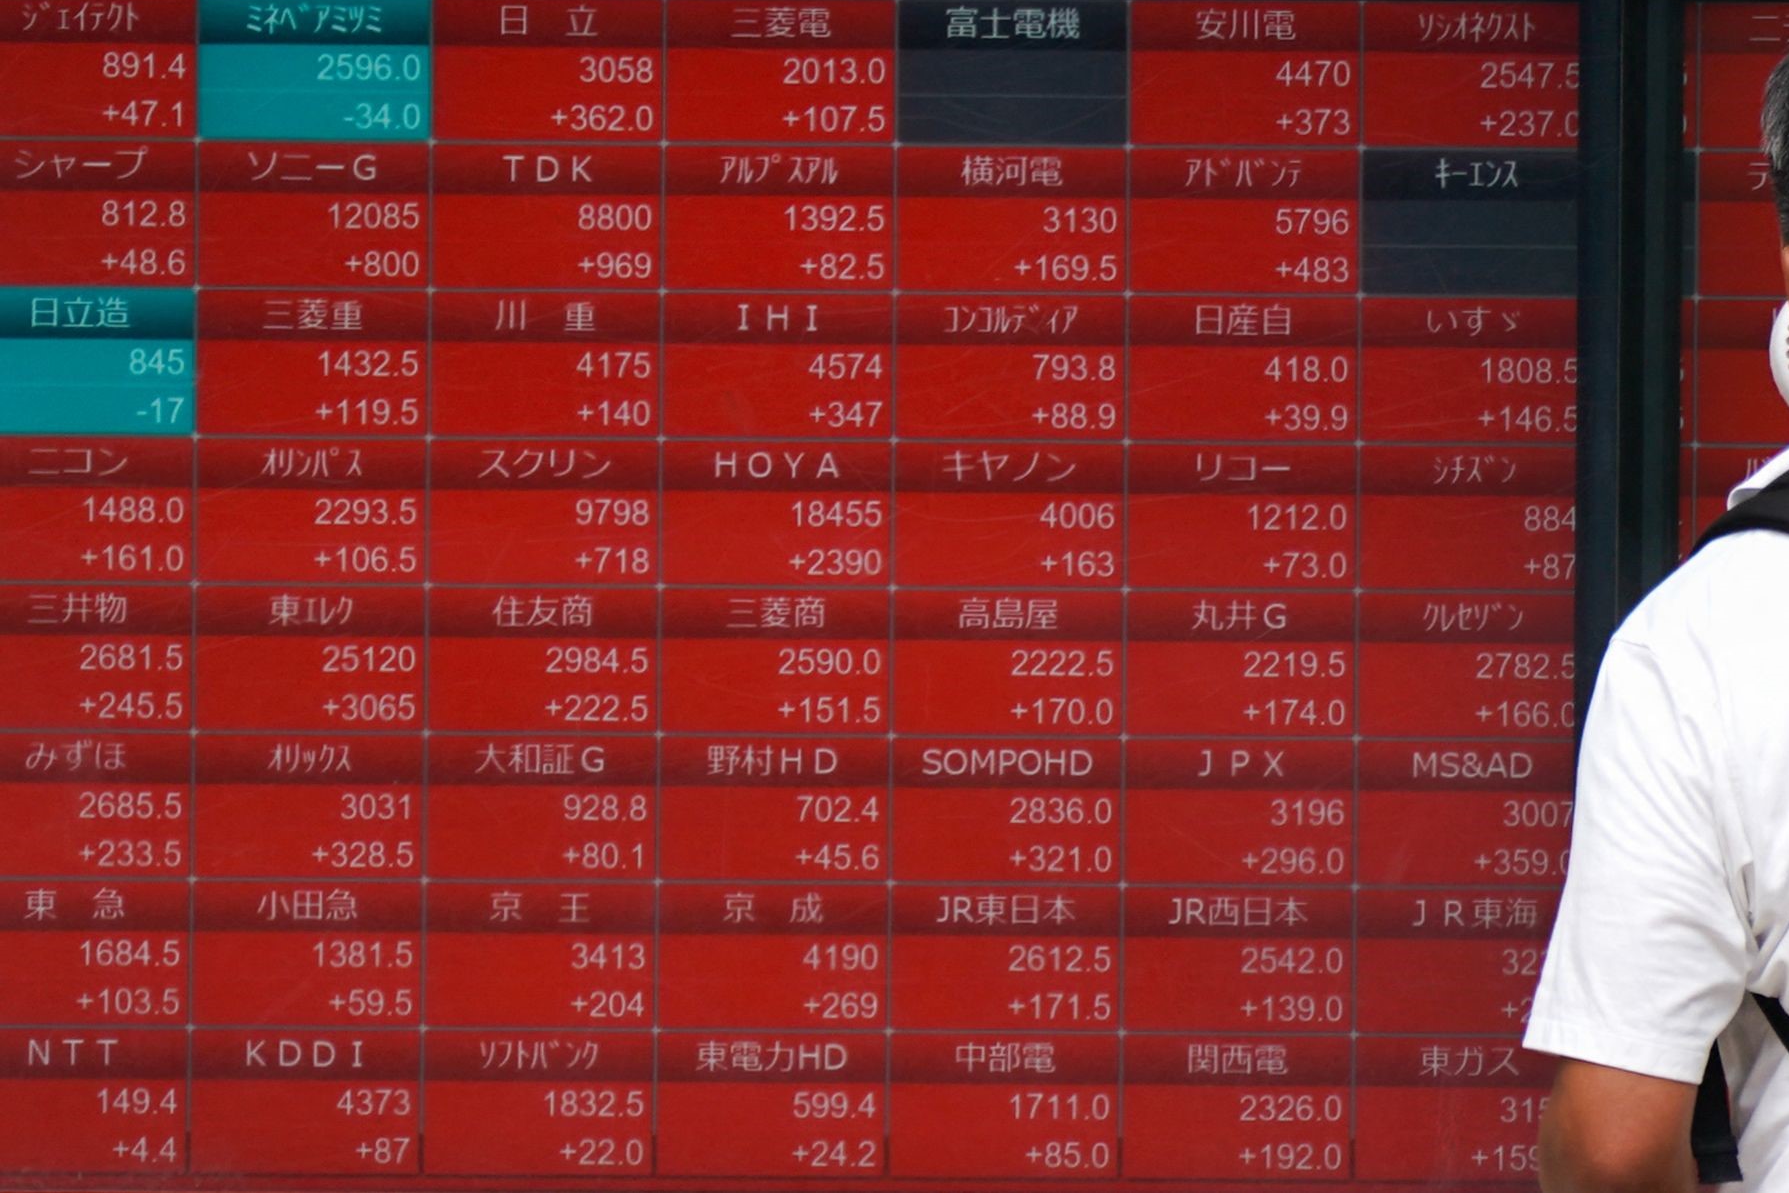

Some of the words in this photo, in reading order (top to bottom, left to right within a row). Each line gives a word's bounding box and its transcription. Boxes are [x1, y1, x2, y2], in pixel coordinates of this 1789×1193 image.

[945, 5, 1080, 39] 富士電機
[1196, 8, 1297, 41] 安川電
[1275, 59, 1352, 87] 4470
[1275, 107, 1351, 136] +373
[960, 154, 1063, 187] 横河電
[328, 201, 421, 230] 12085
[1042, 205, 1118, 234] 3130
[344, 250, 420, 278] +800
[1014, 253, 1118, 282] +169.5
[30, 296, 129, 328] 日立造
[129, 348, 185, 375] 845
[136, 396, 185, 424] -17
[478, 448, 611, 479] スクリン
[575, 497, 651, 527] 9798
[575, 545, 650, 575] +718
[29, 591, 128, 624] 三井物
[958, 596, 1058, 630] 高島屋
[79, 642, 184, 671] 2681.5
[1010, 648, 1115, 678] 2222.5
[79, 691, 183, 720] +245.5
[1010, 697, 1114, 726] +170.0
[922, 748, 1093, 777] SOMPOHD
[1412, 751, 1533, 779] MS&AD
[1009, 796, 1113, 825] 2836.0
[1009, 844, 1113, 873] +321.0
[257, 887, 358, 921] 小田急
[936, 893, 1075, 926] JR東日本
[313, 939, 414, 968] 1381.5
[1008, 944, 1112, 973] 2612.5
[329, 988, 413, 1017] +59.5
[1008, 991, 1112, 1021] +171.5
[1187, 1043, 1289, 1075] 関西電
[793, 1090, 877, 1119] 599.4
[1239, 1094, 1343, 1122] 2326.0
[792, 1139, 877, 1168] +24.2
[1238, 1142, 1342, 1171] +192.0
